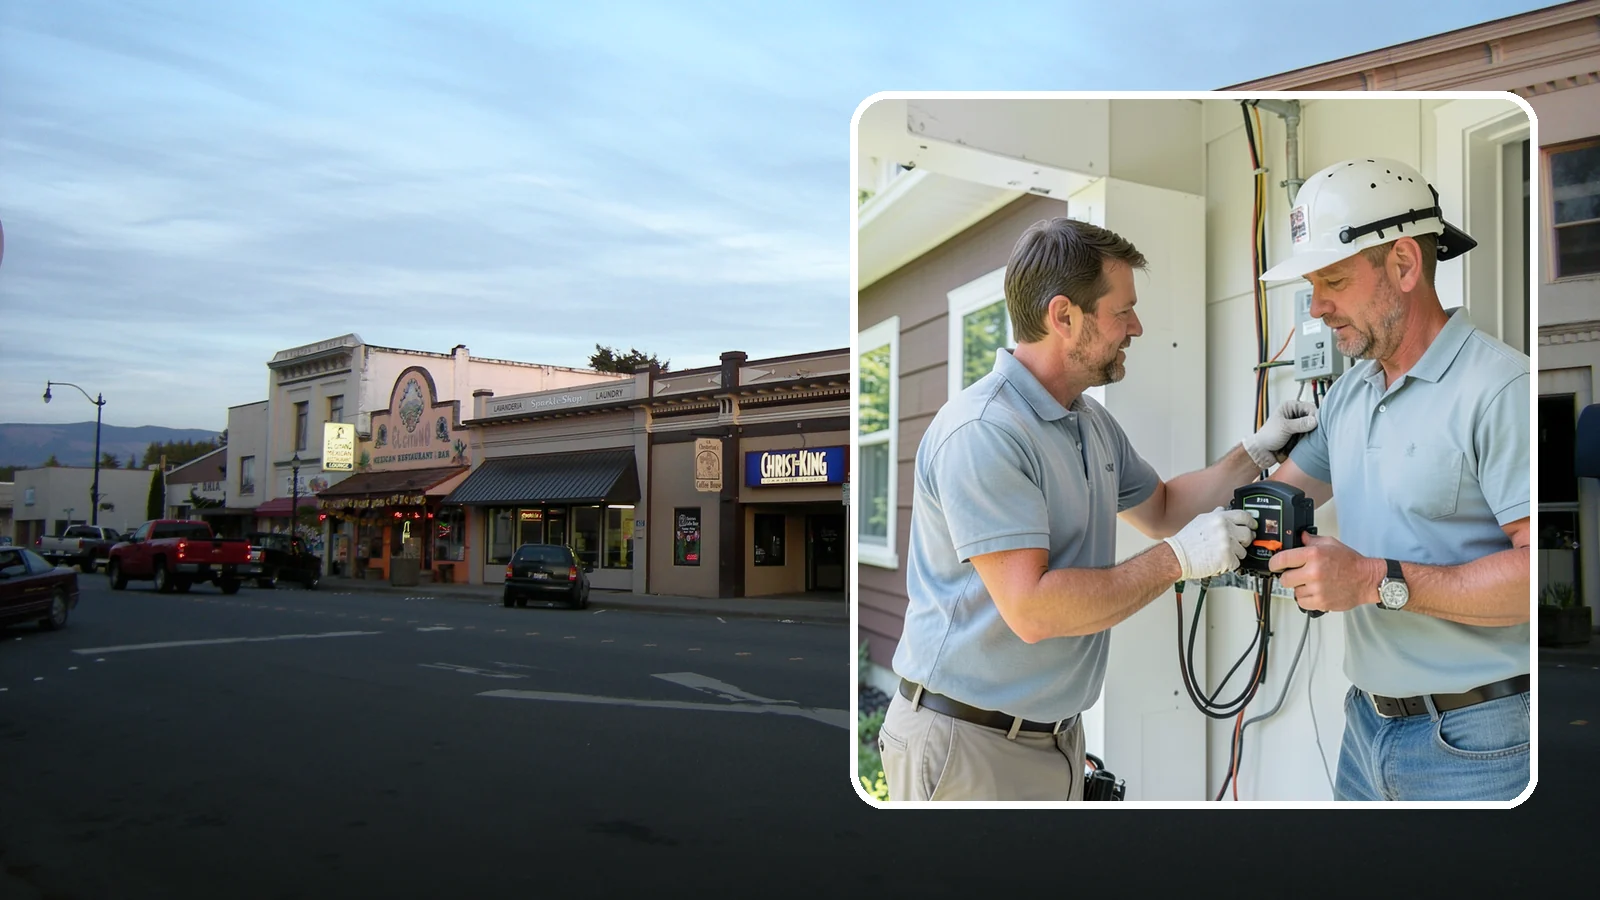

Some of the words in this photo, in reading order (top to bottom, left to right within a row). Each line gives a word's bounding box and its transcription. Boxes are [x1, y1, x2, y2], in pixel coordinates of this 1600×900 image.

[595, 388, 624, 400] LAUNDRY
[493, 402, 523, 413] LAVANDERIA
[530, 396, 560, 409] Sparkle
[561, 394, 583, 405] Shop
[374, 455, 396, 464] MEXICAN
[397, 451, 434, 463] RESTAURANT
[437, 450, 450, 459] BAR
